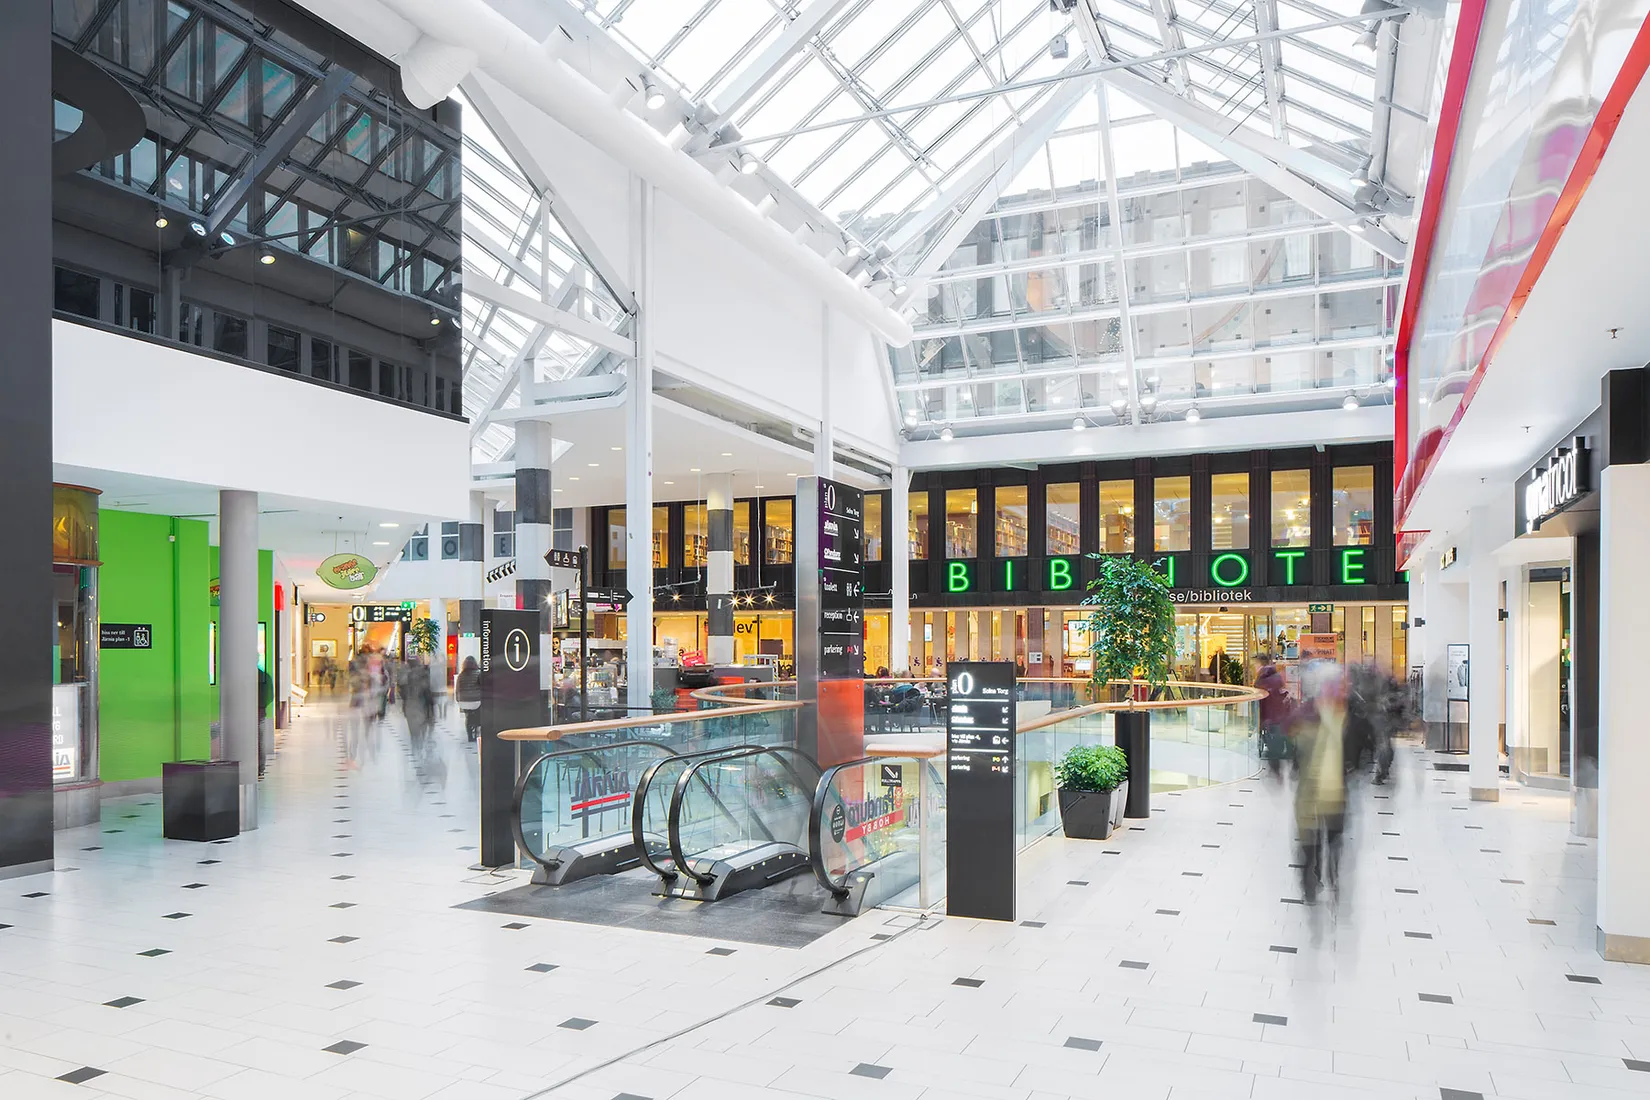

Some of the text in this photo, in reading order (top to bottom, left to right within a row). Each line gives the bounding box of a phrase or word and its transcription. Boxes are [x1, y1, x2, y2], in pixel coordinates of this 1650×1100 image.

[948, 549, 1410, 592] BIBIOTE
[823, 610, 843, 621] reception
[482, 620, 492, 672] information
[823, 645, 843, 656] parkering
[957, 672, 974, 695] 0
